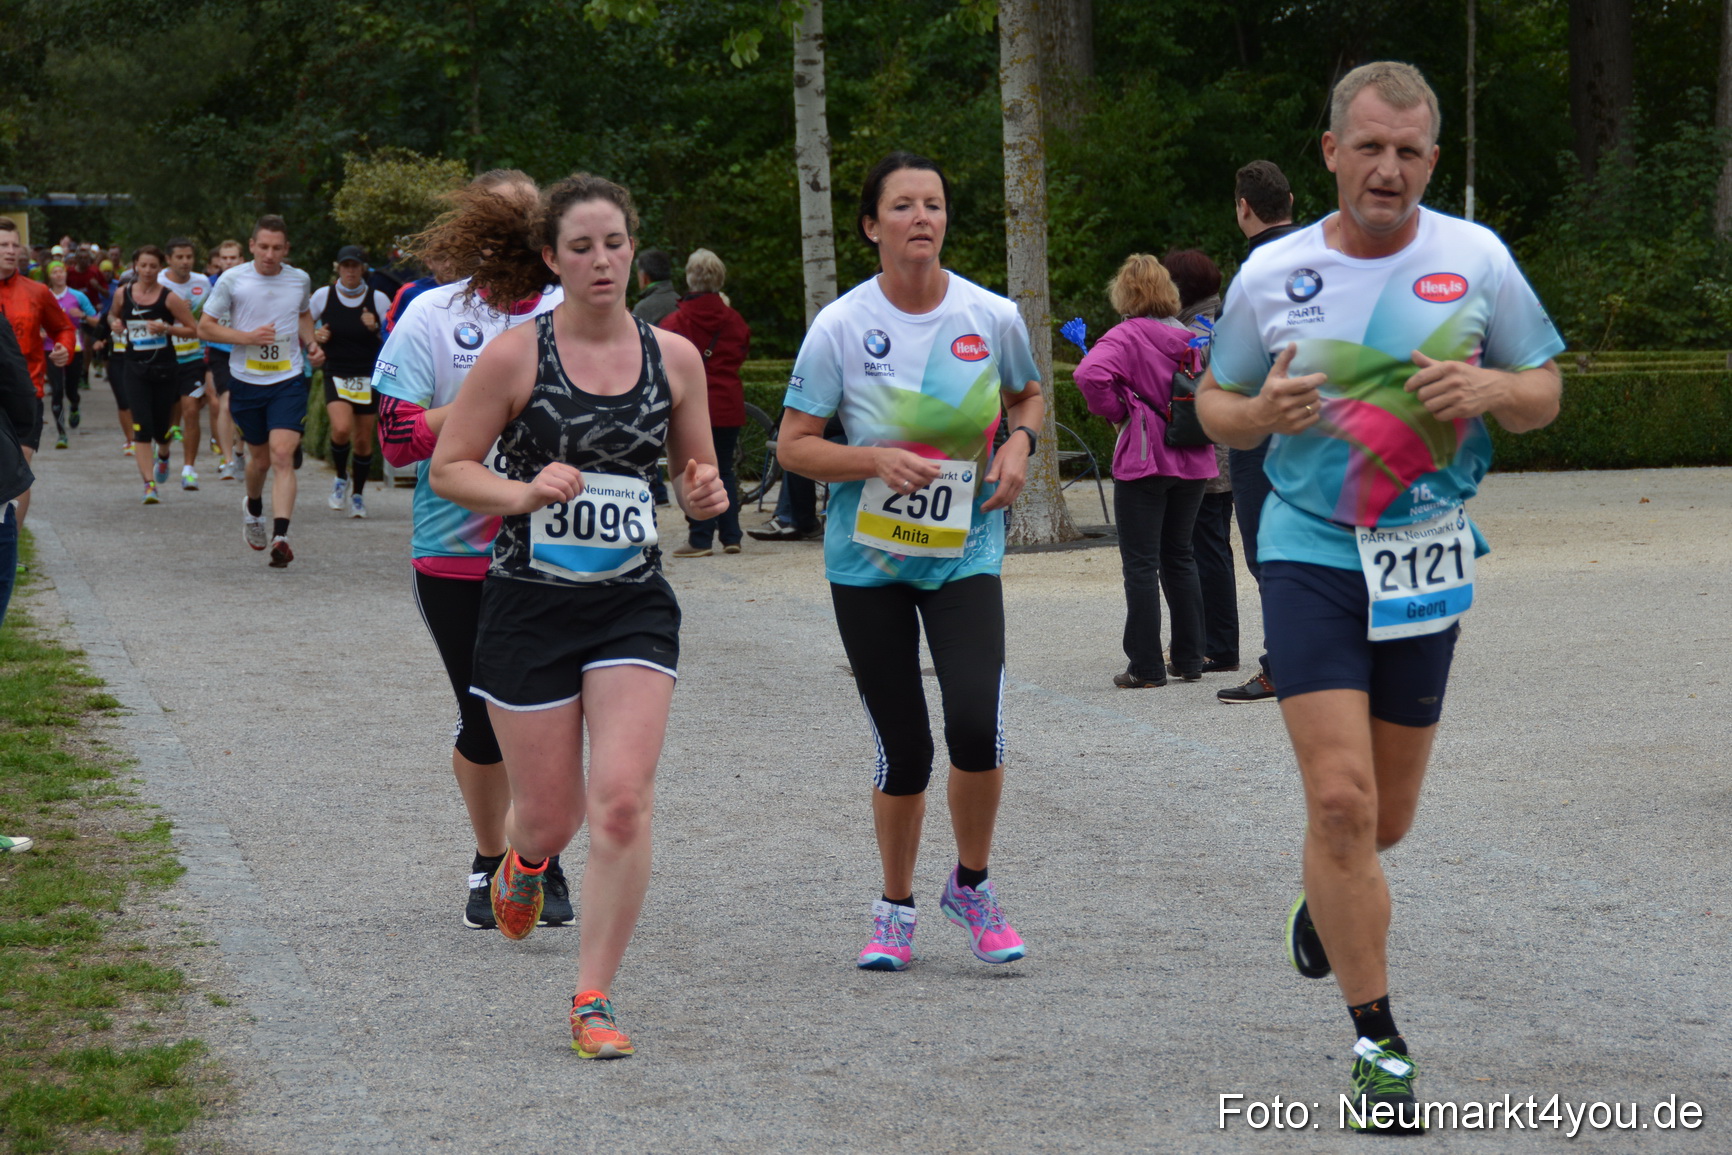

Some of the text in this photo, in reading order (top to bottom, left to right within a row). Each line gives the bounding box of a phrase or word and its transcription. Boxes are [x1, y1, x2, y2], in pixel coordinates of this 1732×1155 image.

[1420, 280, 1463, 295] Hervis
[1288, 305, 1325, 319] PARTL
[260, 345, 279, 360] 38
[956, 342, 989, 354] Hervis
[453, 354, 480, 363] PART
[864, 362, 895, 372] PARTL
[582, 484, 636, 500] Neumarkt
[882, 485, 953, 522] 250
[544, 500, 646, 543] 3096
[892, 525, 930, 544] Anita
[1360, 522, 1454, 544] PARTL Neumarkt
[1373, 537, 1464, 592] 2121
[1406, 600, 1447, 619] Georg
